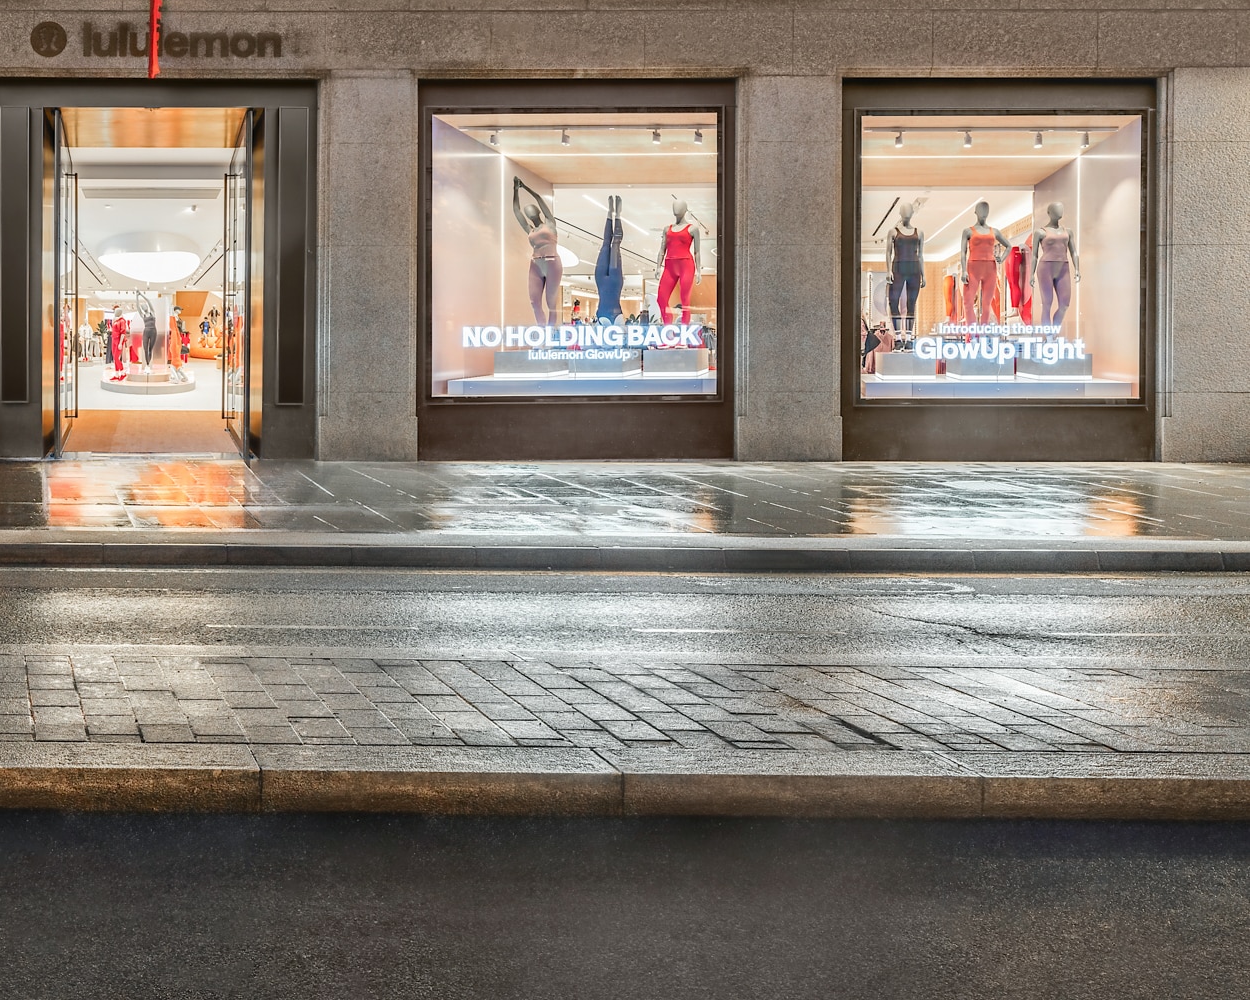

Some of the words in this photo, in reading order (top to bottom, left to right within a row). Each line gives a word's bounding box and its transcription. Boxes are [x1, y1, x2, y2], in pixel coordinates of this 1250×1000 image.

[83, 21, 282, 57] lululemon
[462, 326, 502, 347] NO
[506, 326, 624, 347] HOLDING
[627, 325, 701, 347] BACK
[939, 323, 1011, 336] Introducing
[1012, 323, 1033, 334] the
[1035, 325, 1061, 334] new
[528, 349, 583, 361] lululemon
[585, 349, 631, 362] GlowUp
[915, 336, 1016, 364] GlowUp
[1017, 336, 1085, 364] Tight
